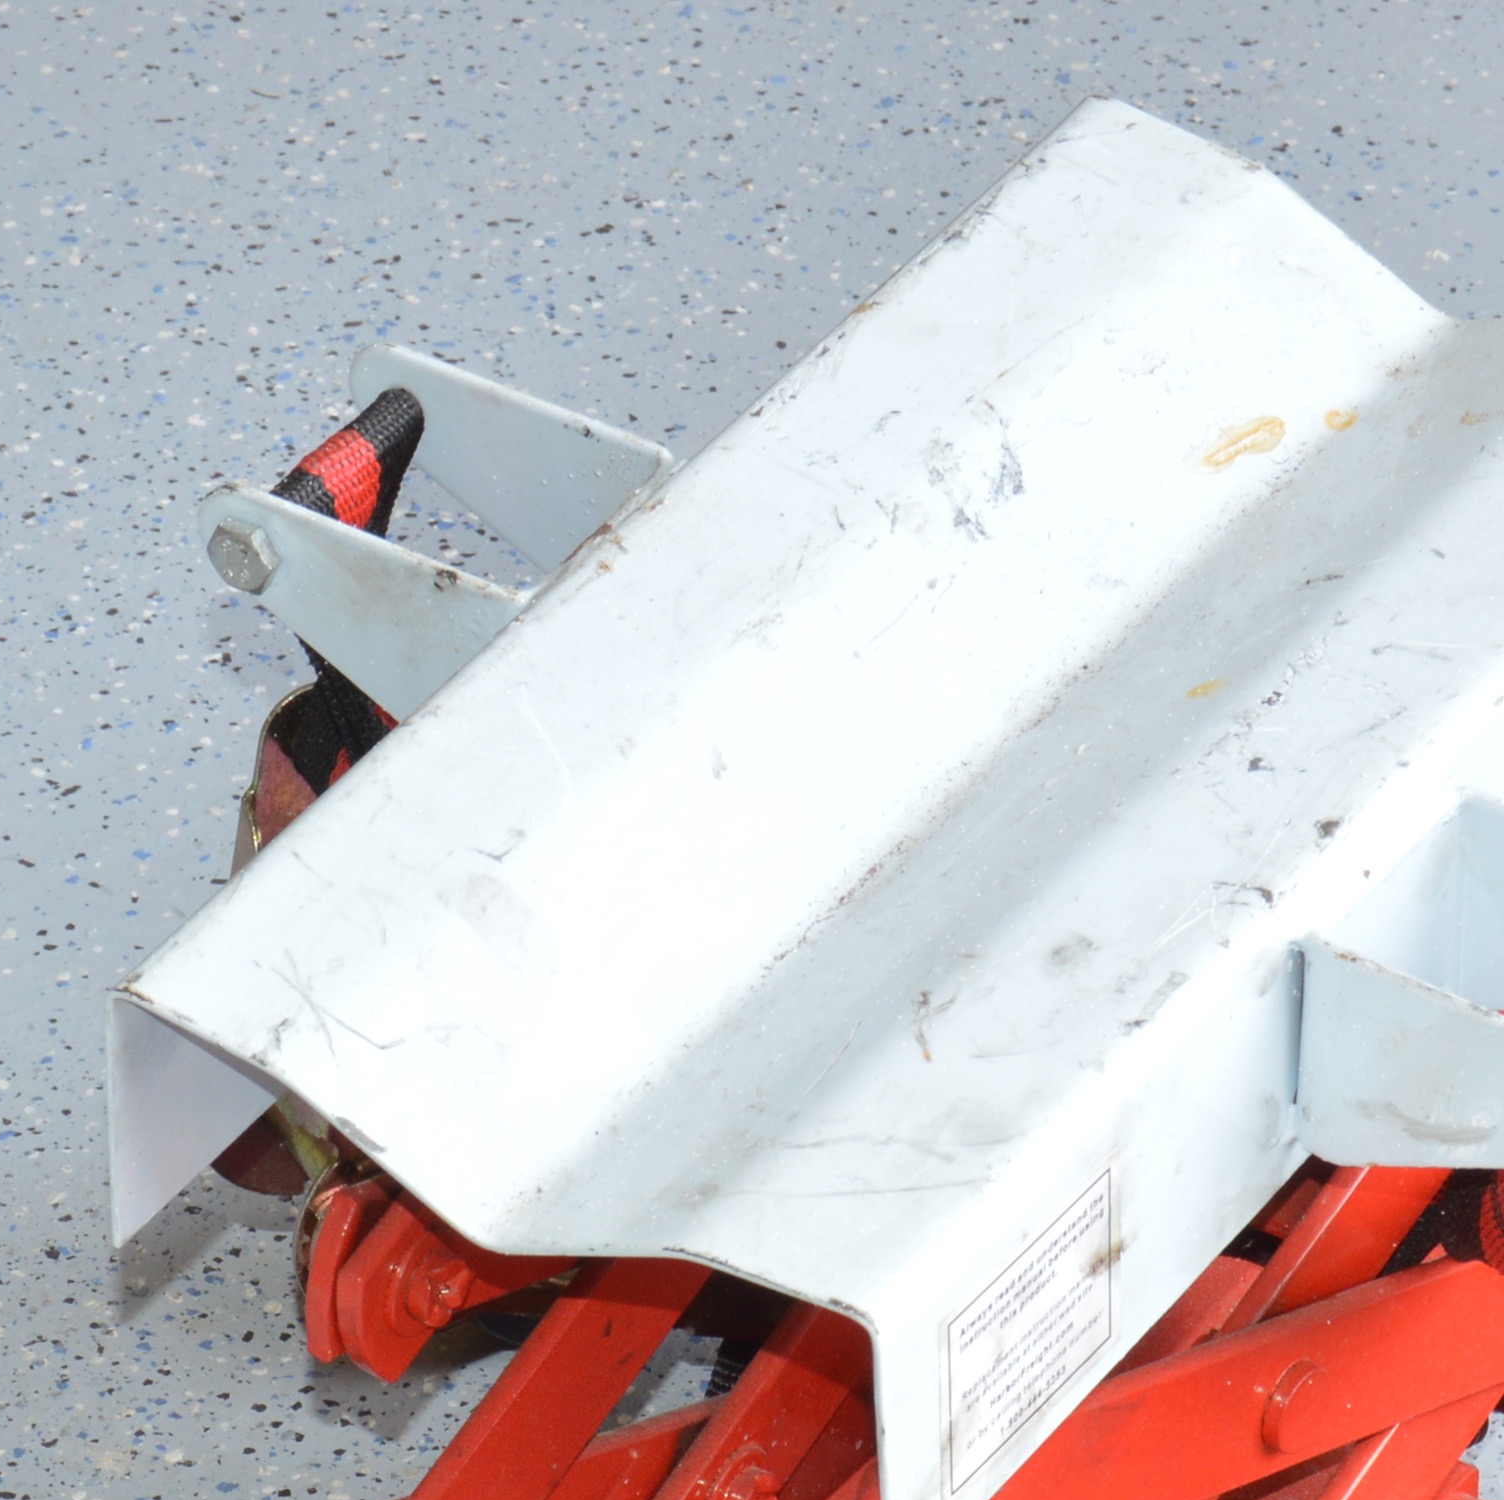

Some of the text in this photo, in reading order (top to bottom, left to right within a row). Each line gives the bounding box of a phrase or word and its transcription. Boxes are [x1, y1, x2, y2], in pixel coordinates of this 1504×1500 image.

[959, 1190, 1104, 1342] Always read and understand the
[959, 1204, 1104, 1355] instruction manual before using
[999, 1305, 1016, 1331] this
[1019, 1291, 1066, 1346] instruction
[966, 1392, 980, 1413] are
[982, 1351, 1020, 1397] available
[1022, 1342, 1031, 1358] at
[1032, 1315, 1057, 1348] either
[966, 1435, 975, 1451] or
[978, 1421, 988, 1442] by
[990, 1388, 1021, 1429] calling
